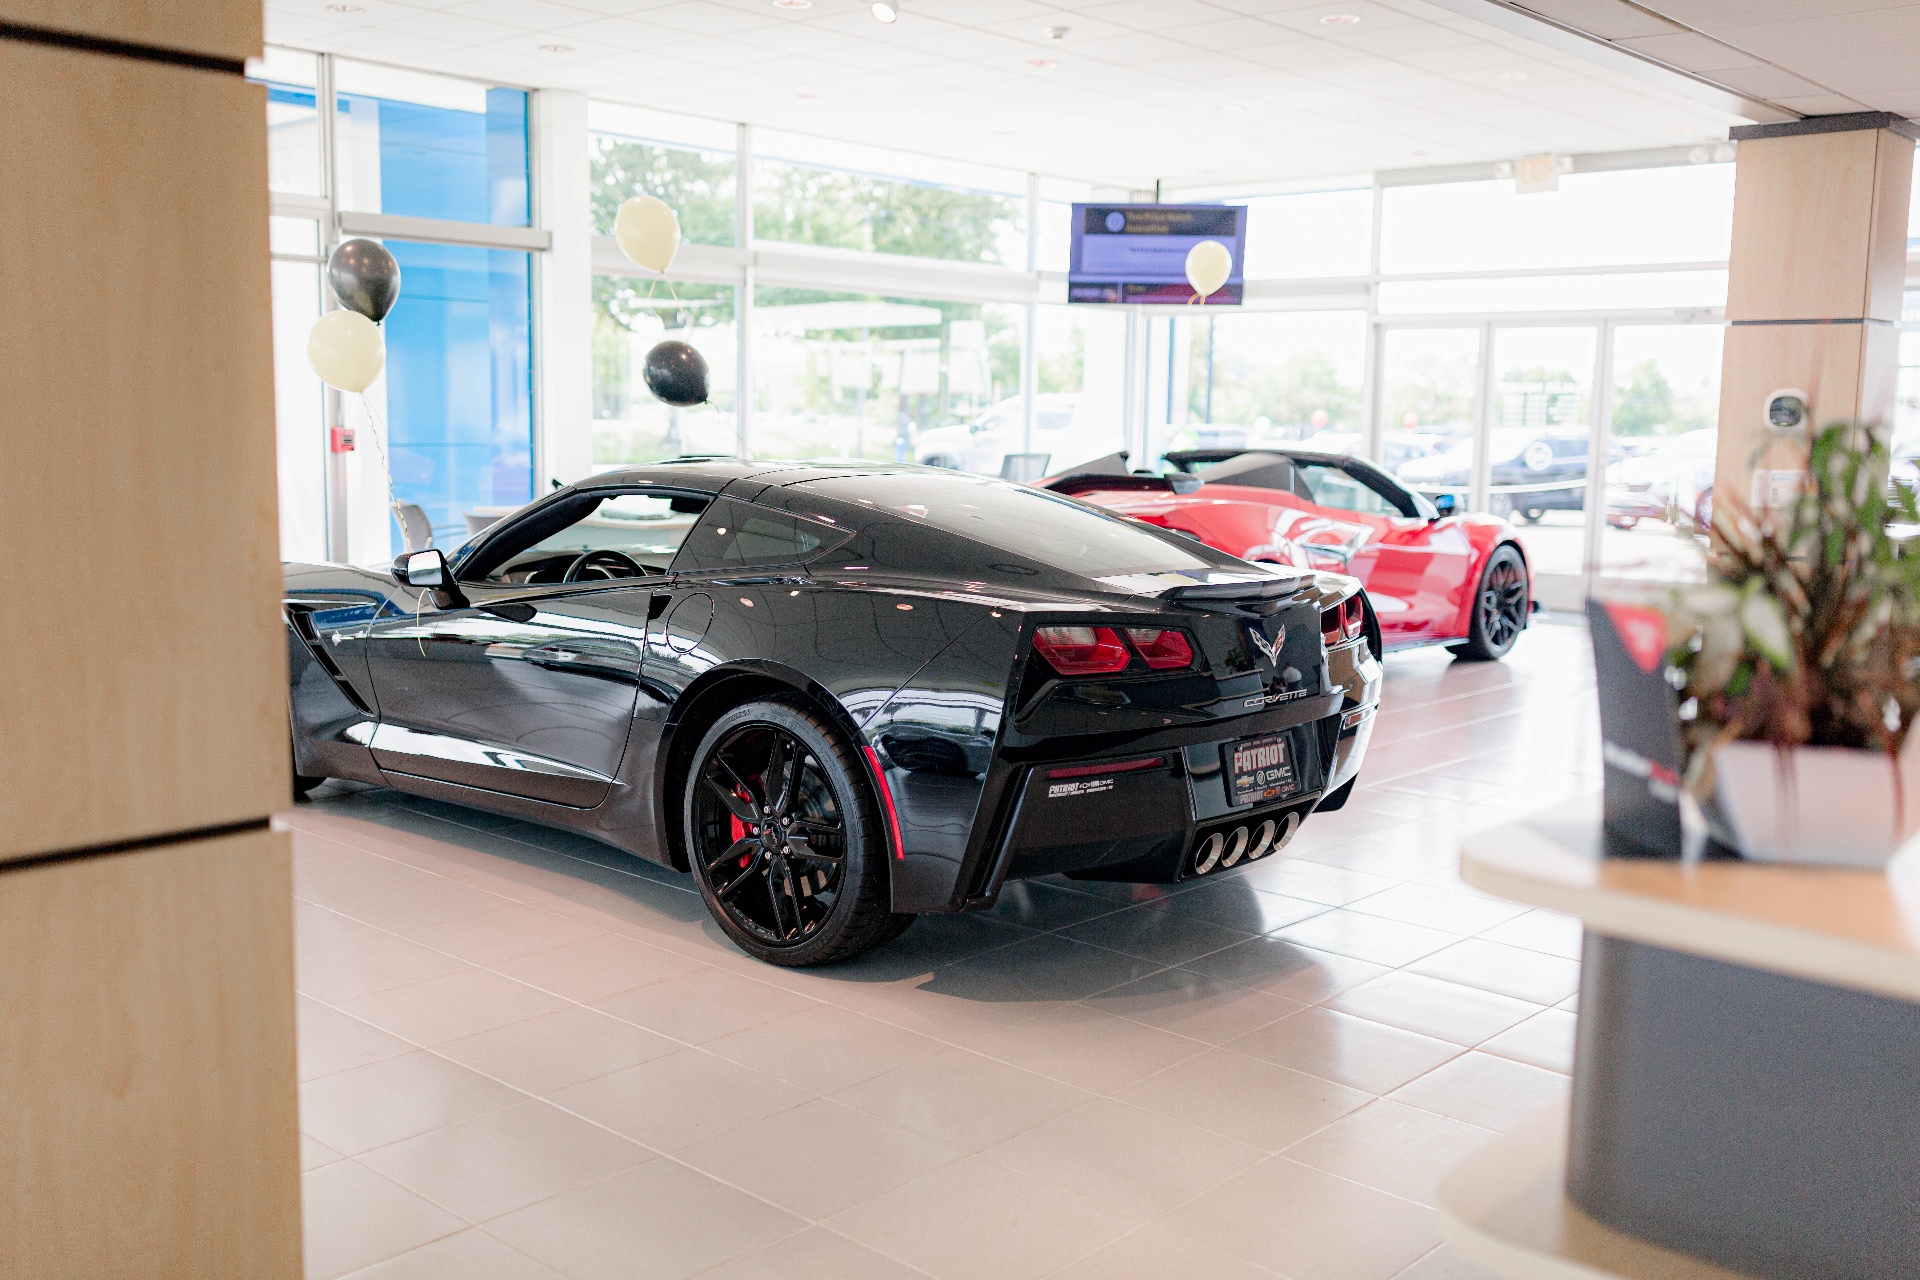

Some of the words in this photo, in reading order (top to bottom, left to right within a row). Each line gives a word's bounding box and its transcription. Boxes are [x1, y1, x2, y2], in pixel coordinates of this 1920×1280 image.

[1244, 689, 1307, 707] CORVETTE
[1234, 743, 1284, 774] PATRIOT
[1266, 766, 1291, 780] GMC
[1049, 782, 1080, 794] PATRIOT
[1240, 790, 1264, 805] PATRIOT
[1281, 784, 1295, 793] GMC
